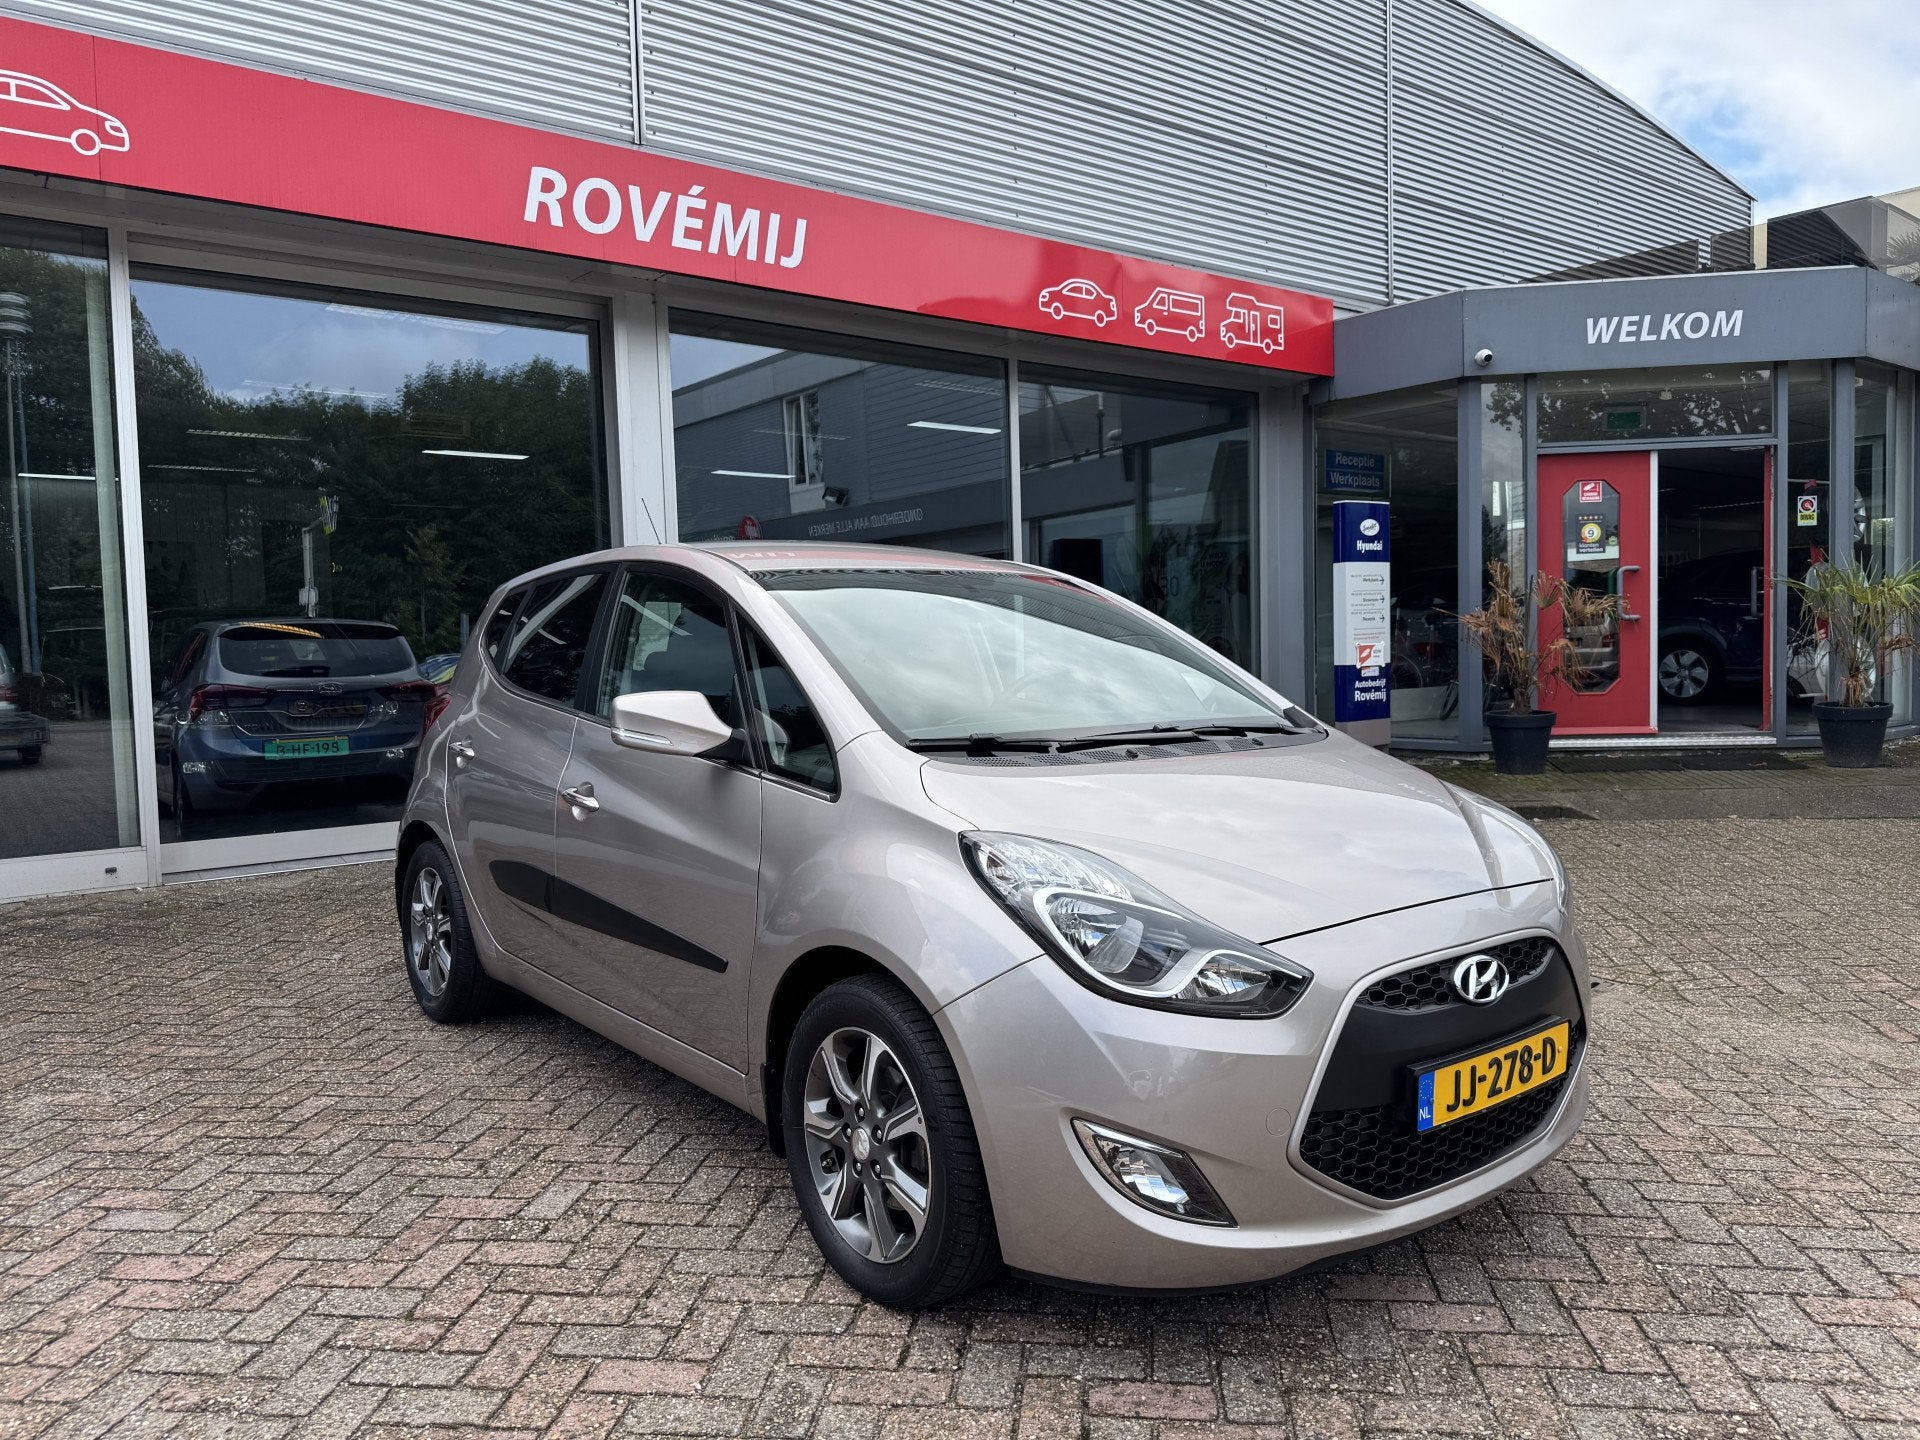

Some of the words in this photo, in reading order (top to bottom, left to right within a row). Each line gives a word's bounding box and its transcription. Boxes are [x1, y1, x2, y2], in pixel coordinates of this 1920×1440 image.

[524, 166, 807, 268] ROVÉMIJ
[1586, 309, 1743, 345] WELKOM
[1335, 452, 1376, 468] Receptie
[1330, 471, 1380, 488] Werkplaats
[1356, 539, 1383, 554] Hyundai
[1354, 678, 1386, 689] Autobedrijf
[1354, 689, 1387, 702] Rovémij
[1446, 1036, 1557, 1113] JJ-278-D
[1418, 1106, 1431, 1121] NL
